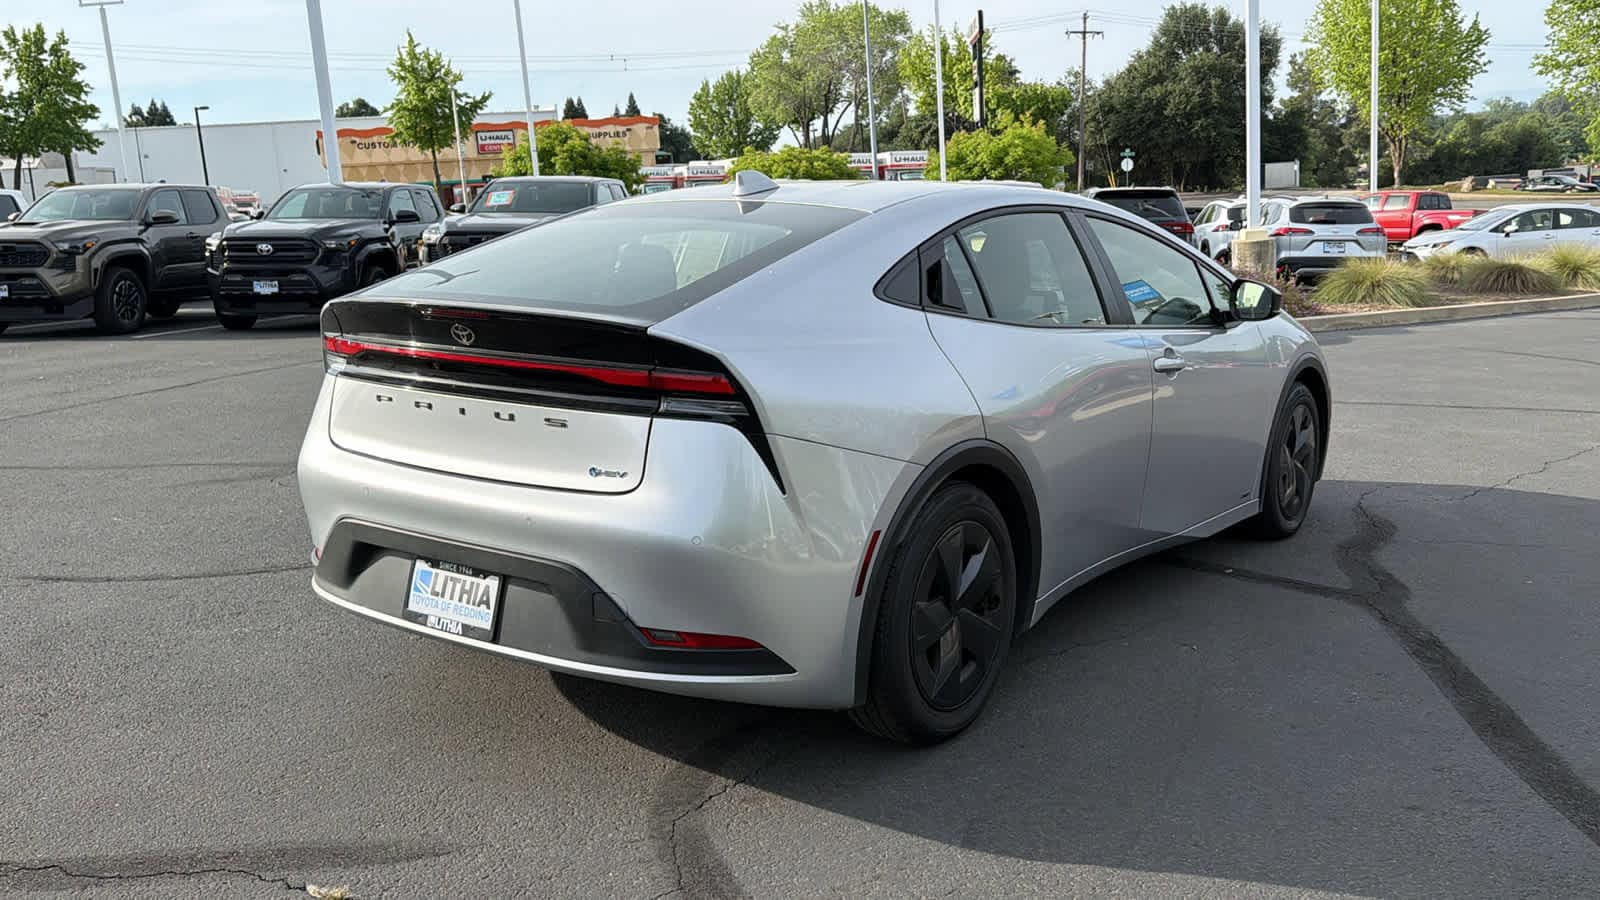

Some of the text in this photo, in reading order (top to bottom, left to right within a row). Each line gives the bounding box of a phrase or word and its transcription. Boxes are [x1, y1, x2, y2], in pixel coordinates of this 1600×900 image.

[590, 130, 627, 139] UPPLIES
[894, 155, 926, 163] U-HAUL
[376, 395, 569, 428] PRIUS
[439, 561, 457, 572] SINCE
[430, 571, 491, 611] LITHIA
[412, 593, 491, 623] TOYOTA OF REDDING
[435, 615, 463, 635] LITHIA
